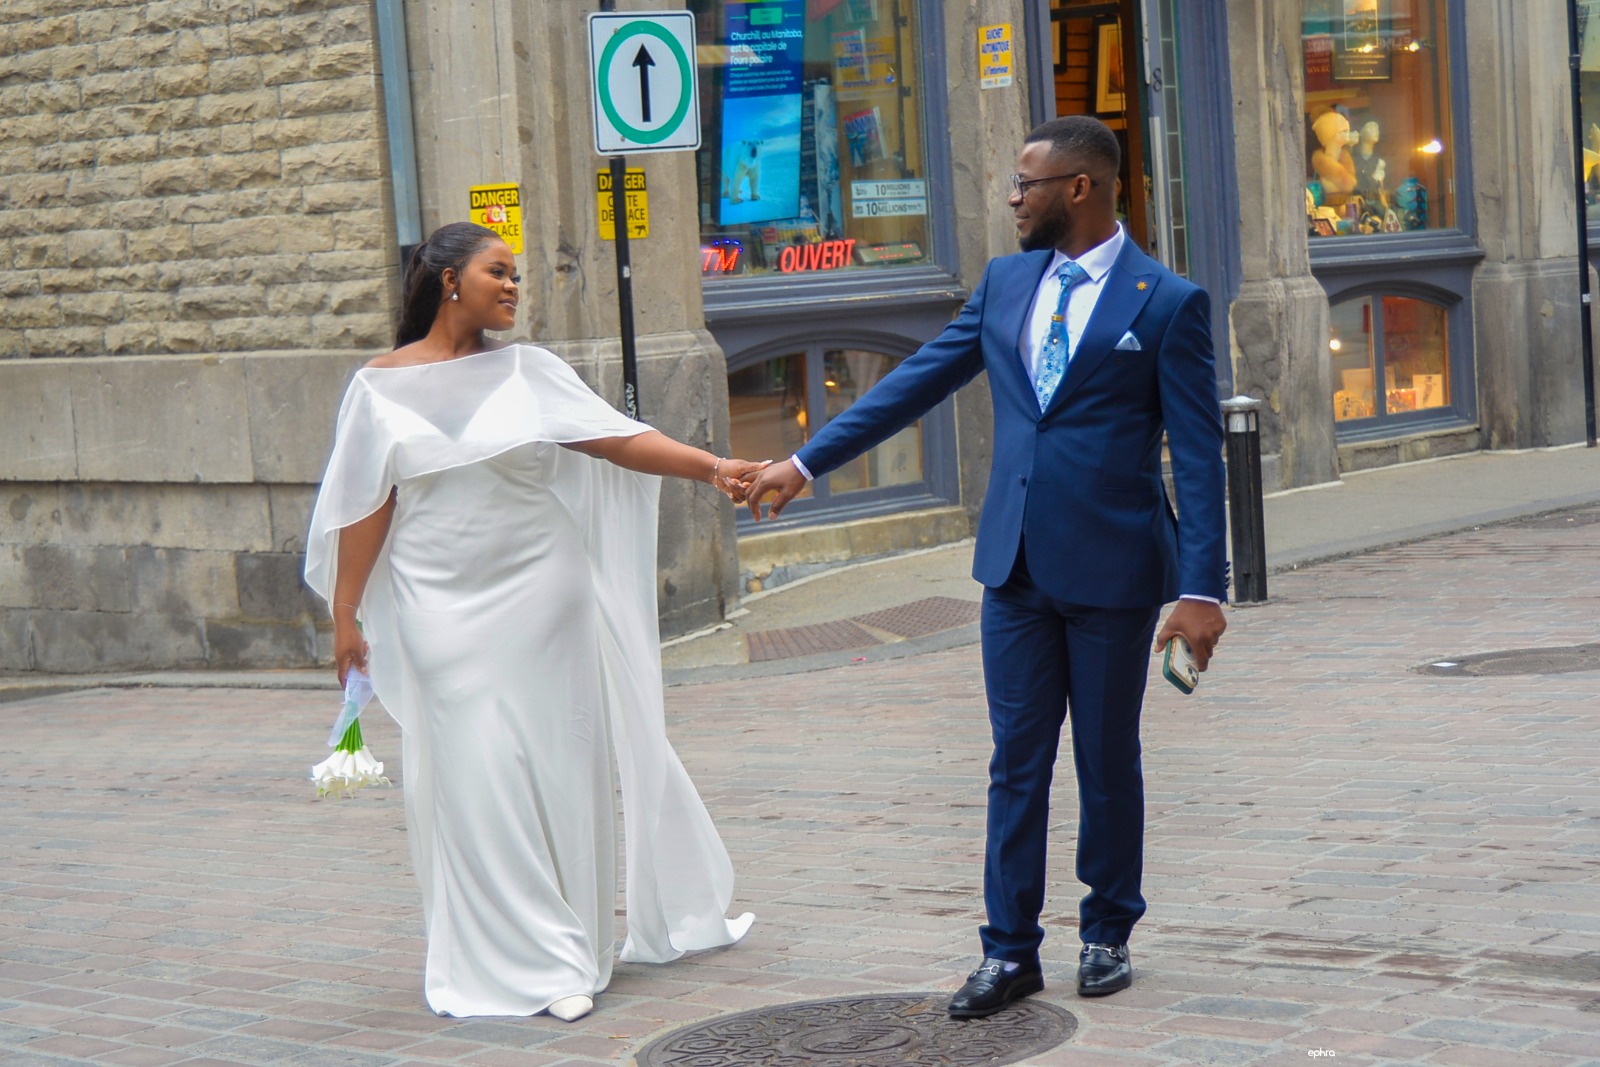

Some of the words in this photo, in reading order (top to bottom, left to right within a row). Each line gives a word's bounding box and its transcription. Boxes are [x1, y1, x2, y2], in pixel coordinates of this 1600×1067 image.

[731, 30, 761, 41] Churchill,
[771, 29, 803, 39] Manitoba,
[730, 44, 742, 53] est
[750, 42, 777, 54] capitale
[778, 41, 787, 50] de
[1152, 67, 1163, 93] 8
[599, 174, 646, 190] DAGER
[875, 184, 886, 196] 10
[471, 189, 519, 208] DANGER
[608, 194, 638, 207] CTE
[627, 208, 646, 221] ACE
[866, 202, 877, 216] 10
[781, 239, 855, 273] OUVERT
